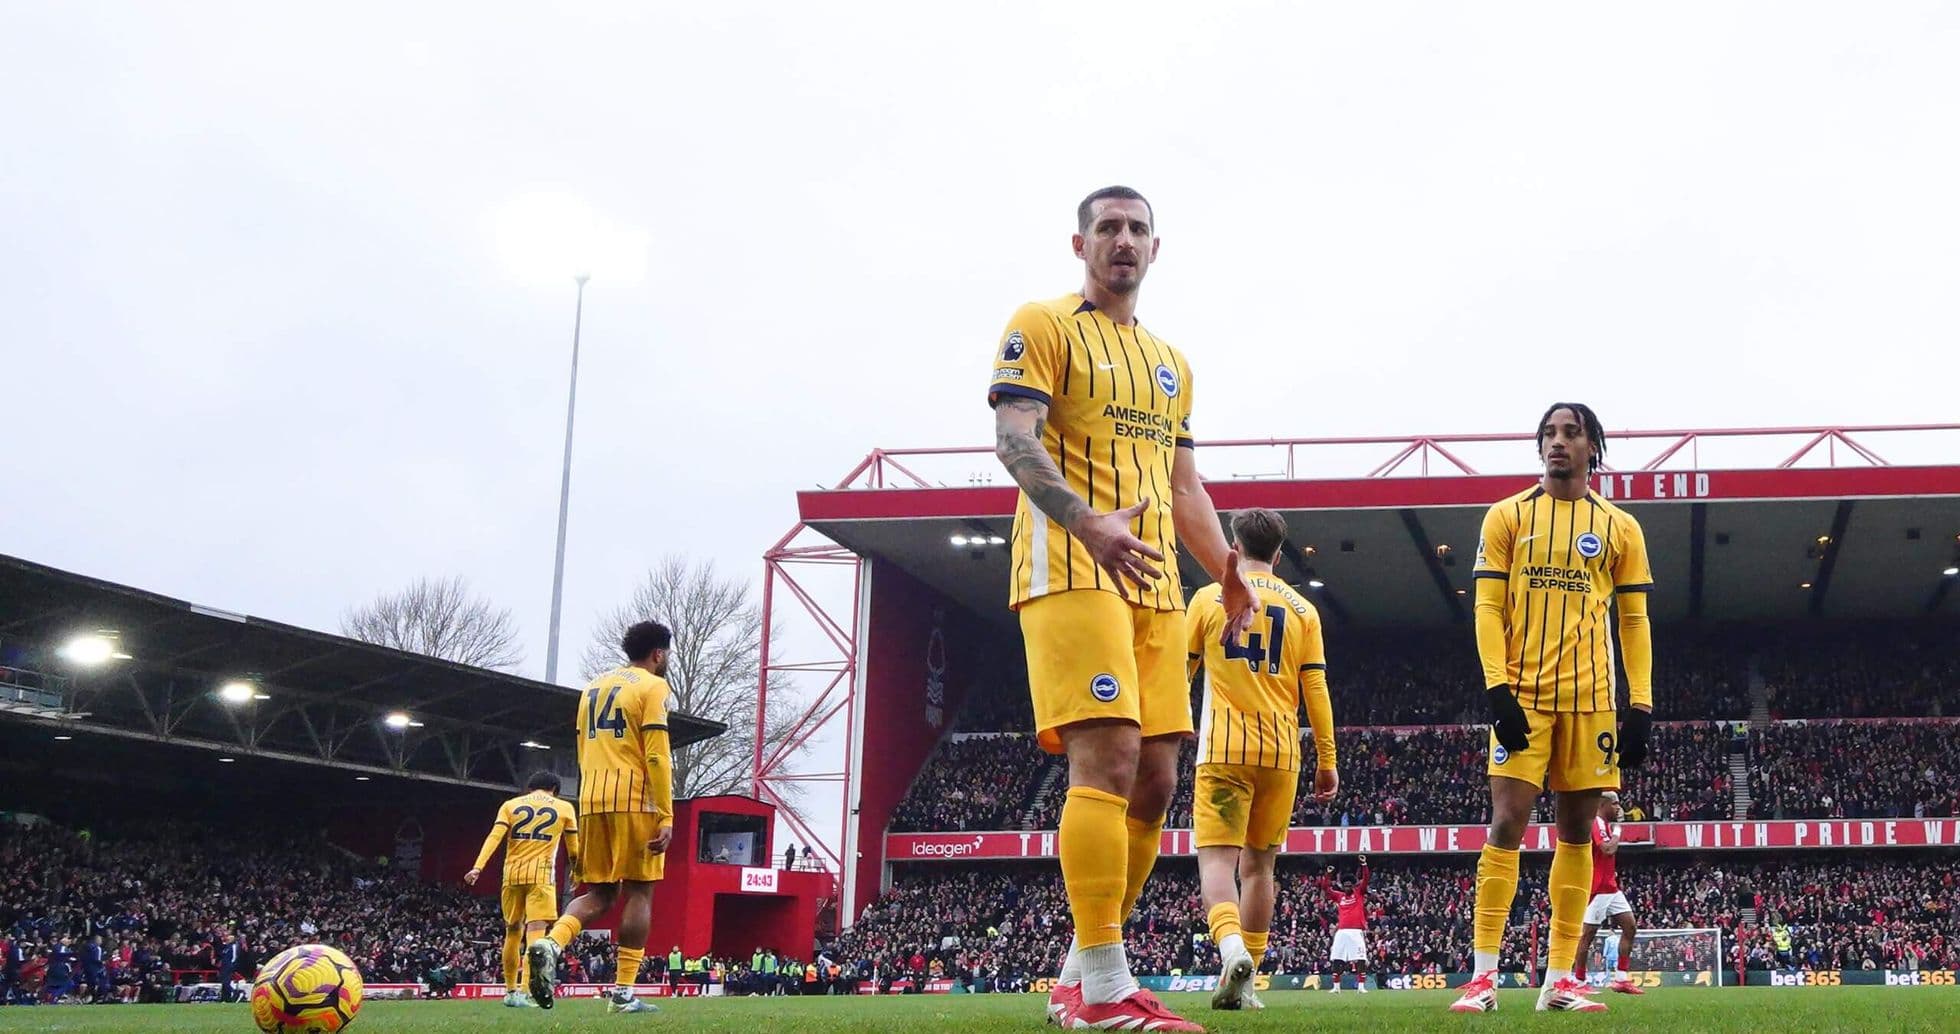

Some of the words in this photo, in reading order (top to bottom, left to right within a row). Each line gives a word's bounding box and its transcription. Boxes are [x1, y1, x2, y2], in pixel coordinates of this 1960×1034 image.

[1103, 404, 1172, 432] AMERICN
[1115, 422, 1173, 448] EXPRSS
[1654, 474, 1709, 497] END
[1520, 566, 1590, 582] AMERICAN
[1529, 578, 1592, 594] EXPRESS
[1222, 605, 1286, 675] 41
[587, 686, 627, 739] 14
[1597, 731, 1614, 765] 9
[511, 805, 558, 841] 22
[1685, 823, 1768, 847] WITH
[1795, 822, 1897, 846] PRIDE
[912, 841, 972, 857] Ideagen
[1313, 828, 1392, 852] THAT
[1420, 828, 1459, 851] WE
[747, 873, 772, 887] 24:43
[1385, 974, 1447, 989] et365
[1770, 970, 1841, 986] bet365
[1885, 970, 1956, 986] bet365
